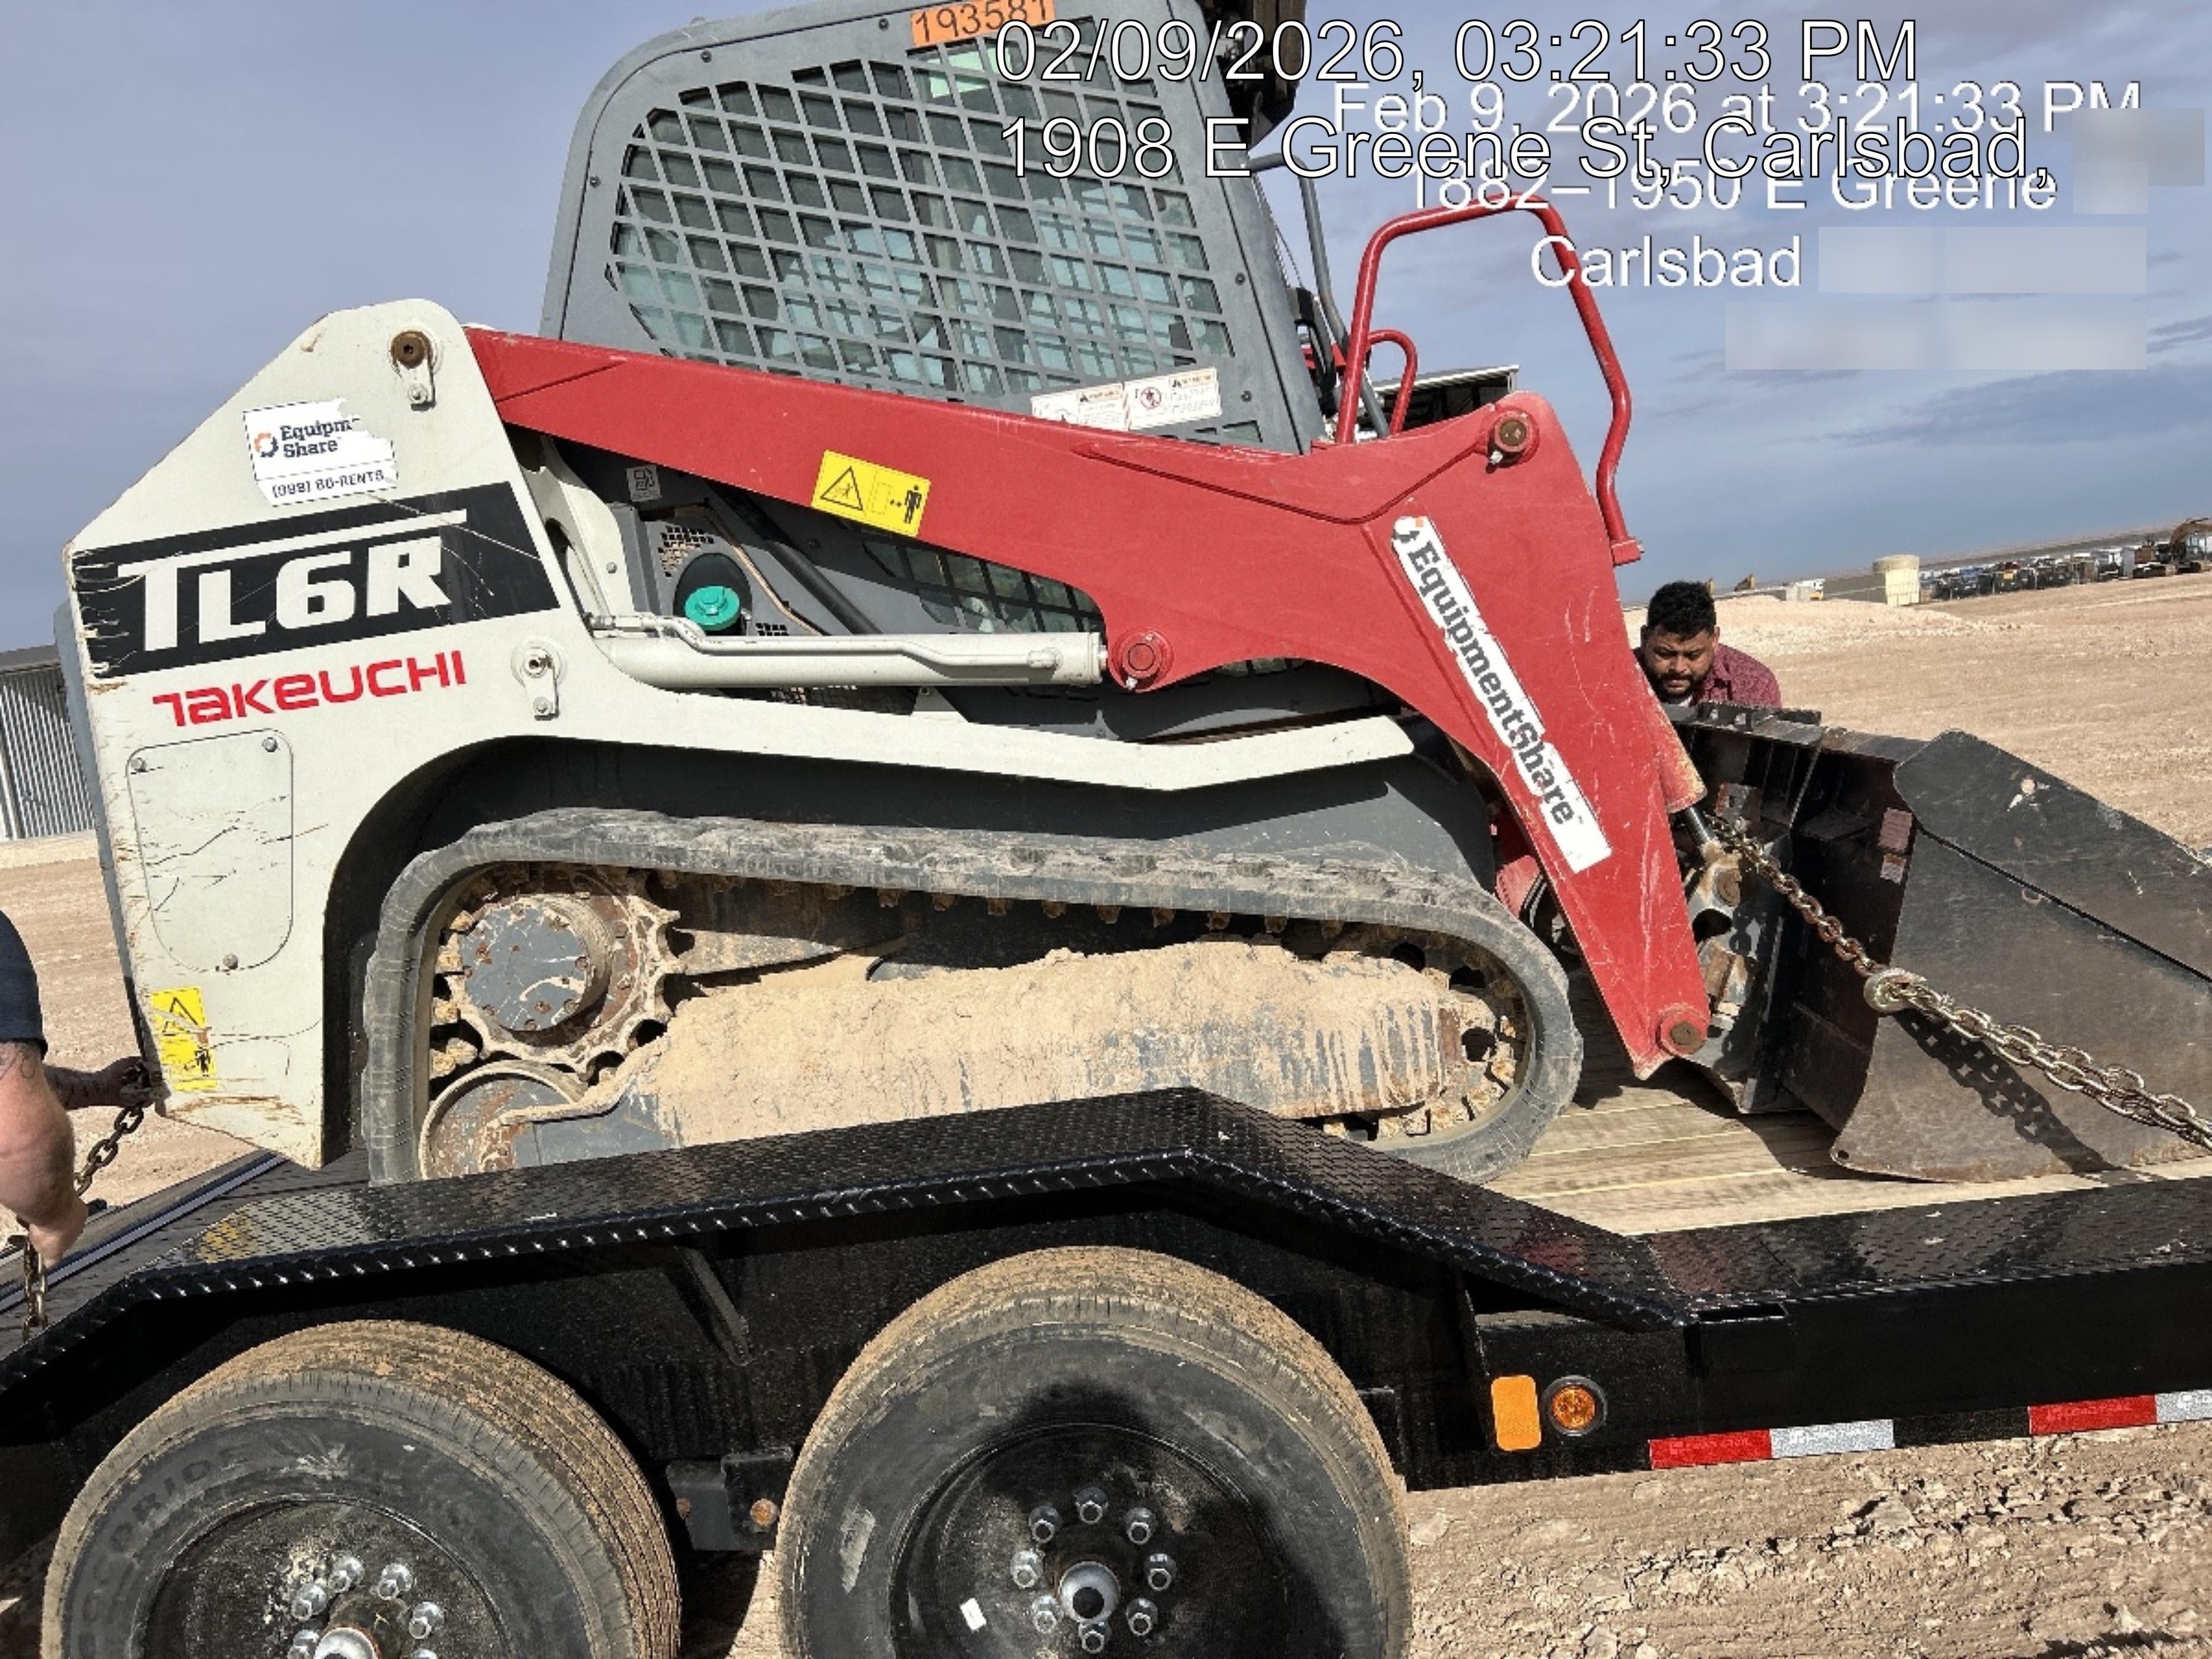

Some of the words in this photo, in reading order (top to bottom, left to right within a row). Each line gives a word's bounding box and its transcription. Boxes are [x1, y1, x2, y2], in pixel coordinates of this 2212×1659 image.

[283, 439, 338, 458] Share
[117, 509, 467, 651] TL6R
[152, 650, 467, 727] TAKEUCHI
[1408, 541, 1574, 825] EquipmentShare
